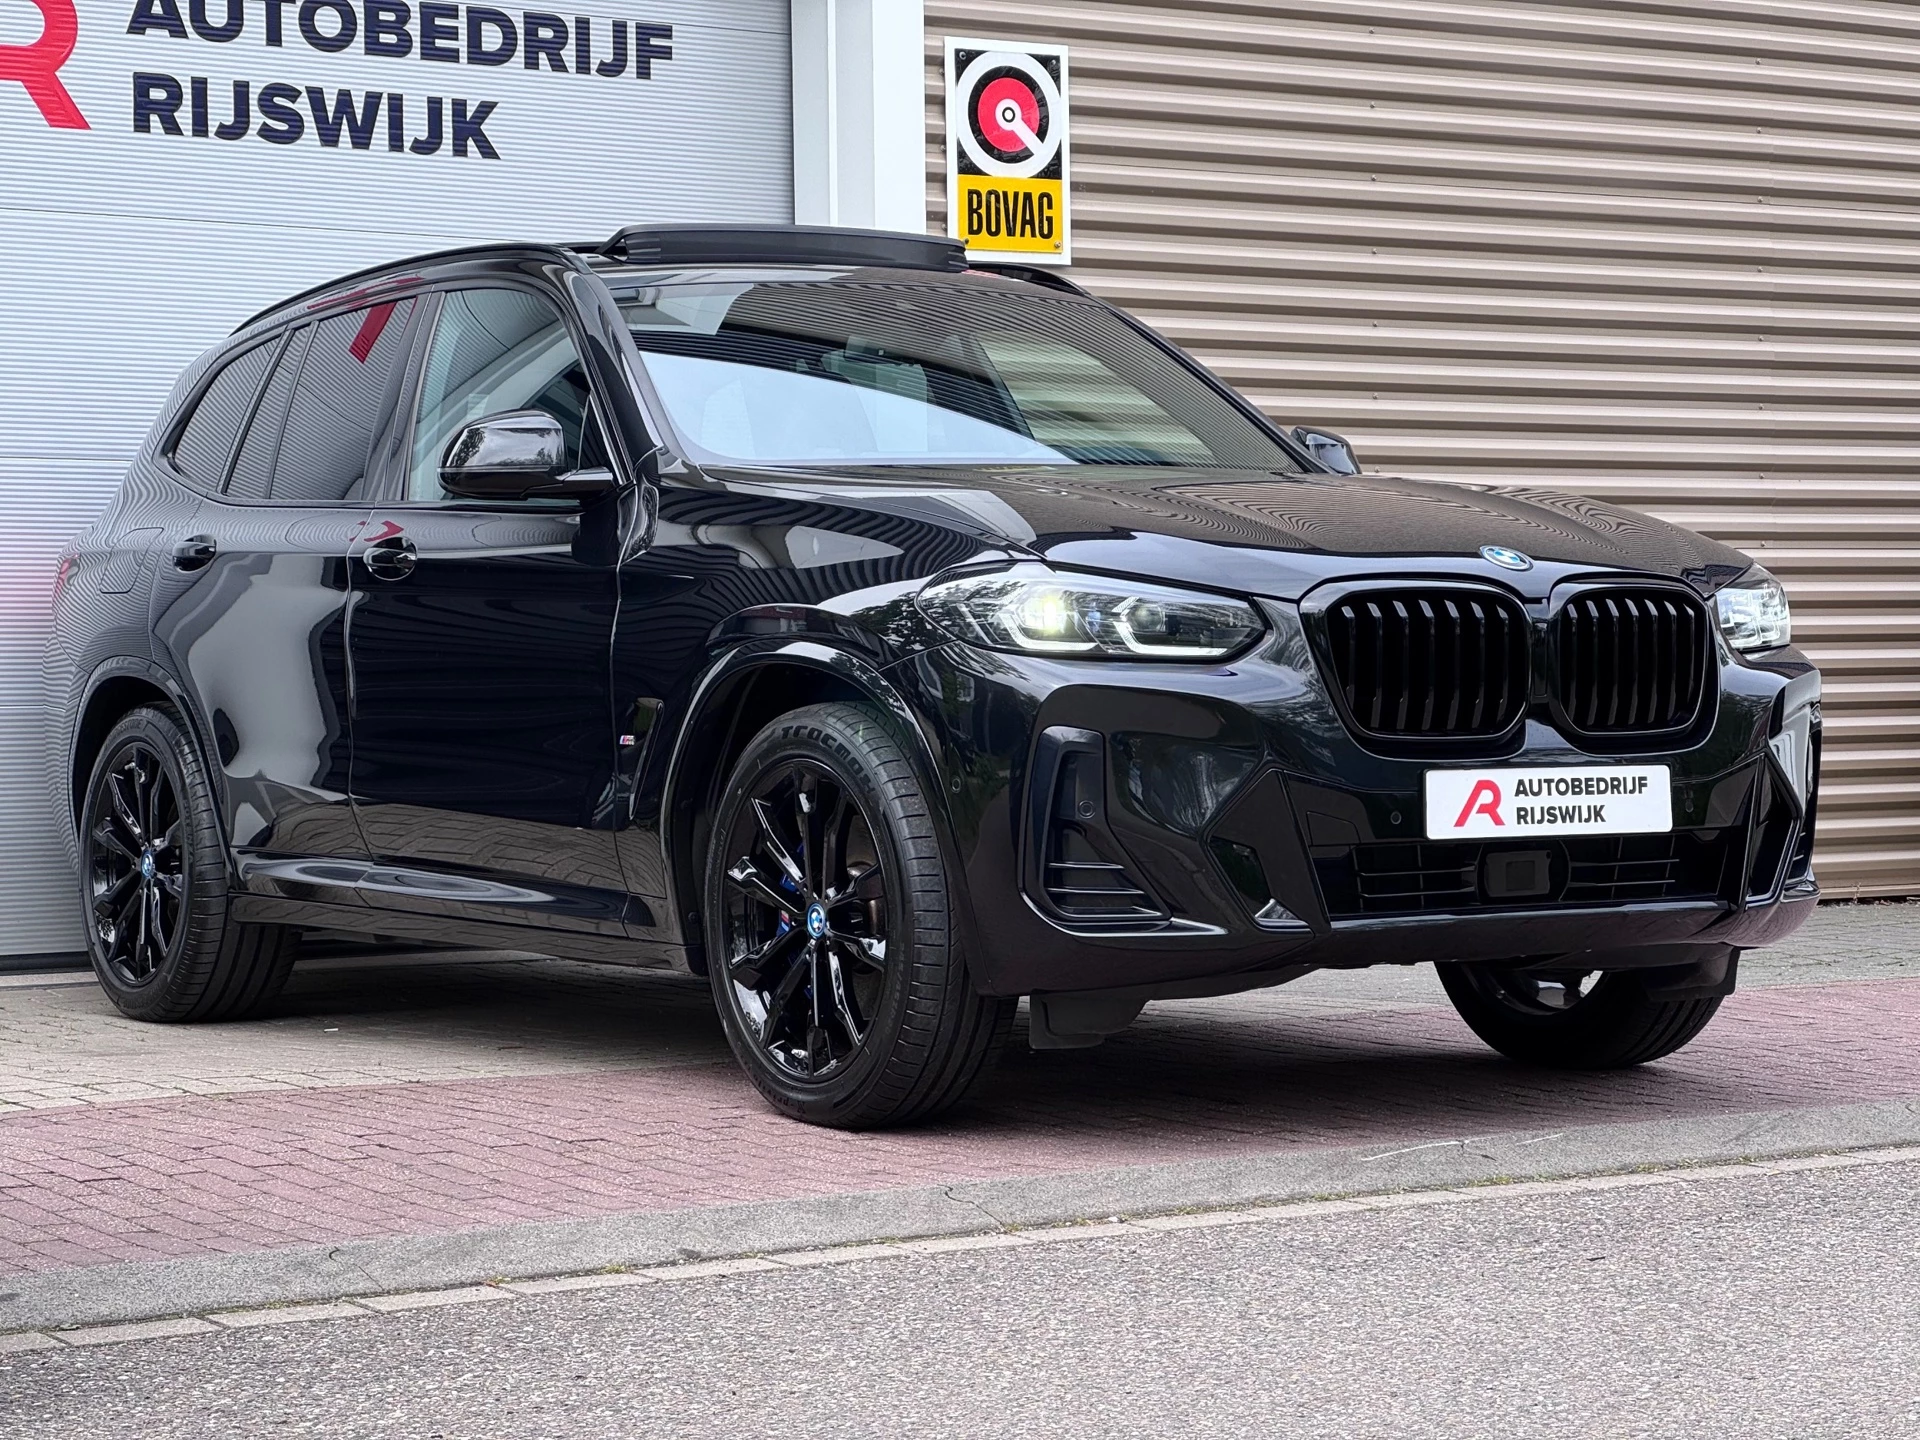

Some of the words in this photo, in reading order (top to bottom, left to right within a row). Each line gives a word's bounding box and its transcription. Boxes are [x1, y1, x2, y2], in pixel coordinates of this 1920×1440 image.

[126, 0, 672, 81] AUTOBEDRIJF
[132, 71, 501, 160] RIJSWIJK
[967, 188, 1054, 240] BOVAG
[1514, 776, 1648, 797] AUTOBEDRIJF
[1516, 804, 1606, 825] RIJSWIJK
